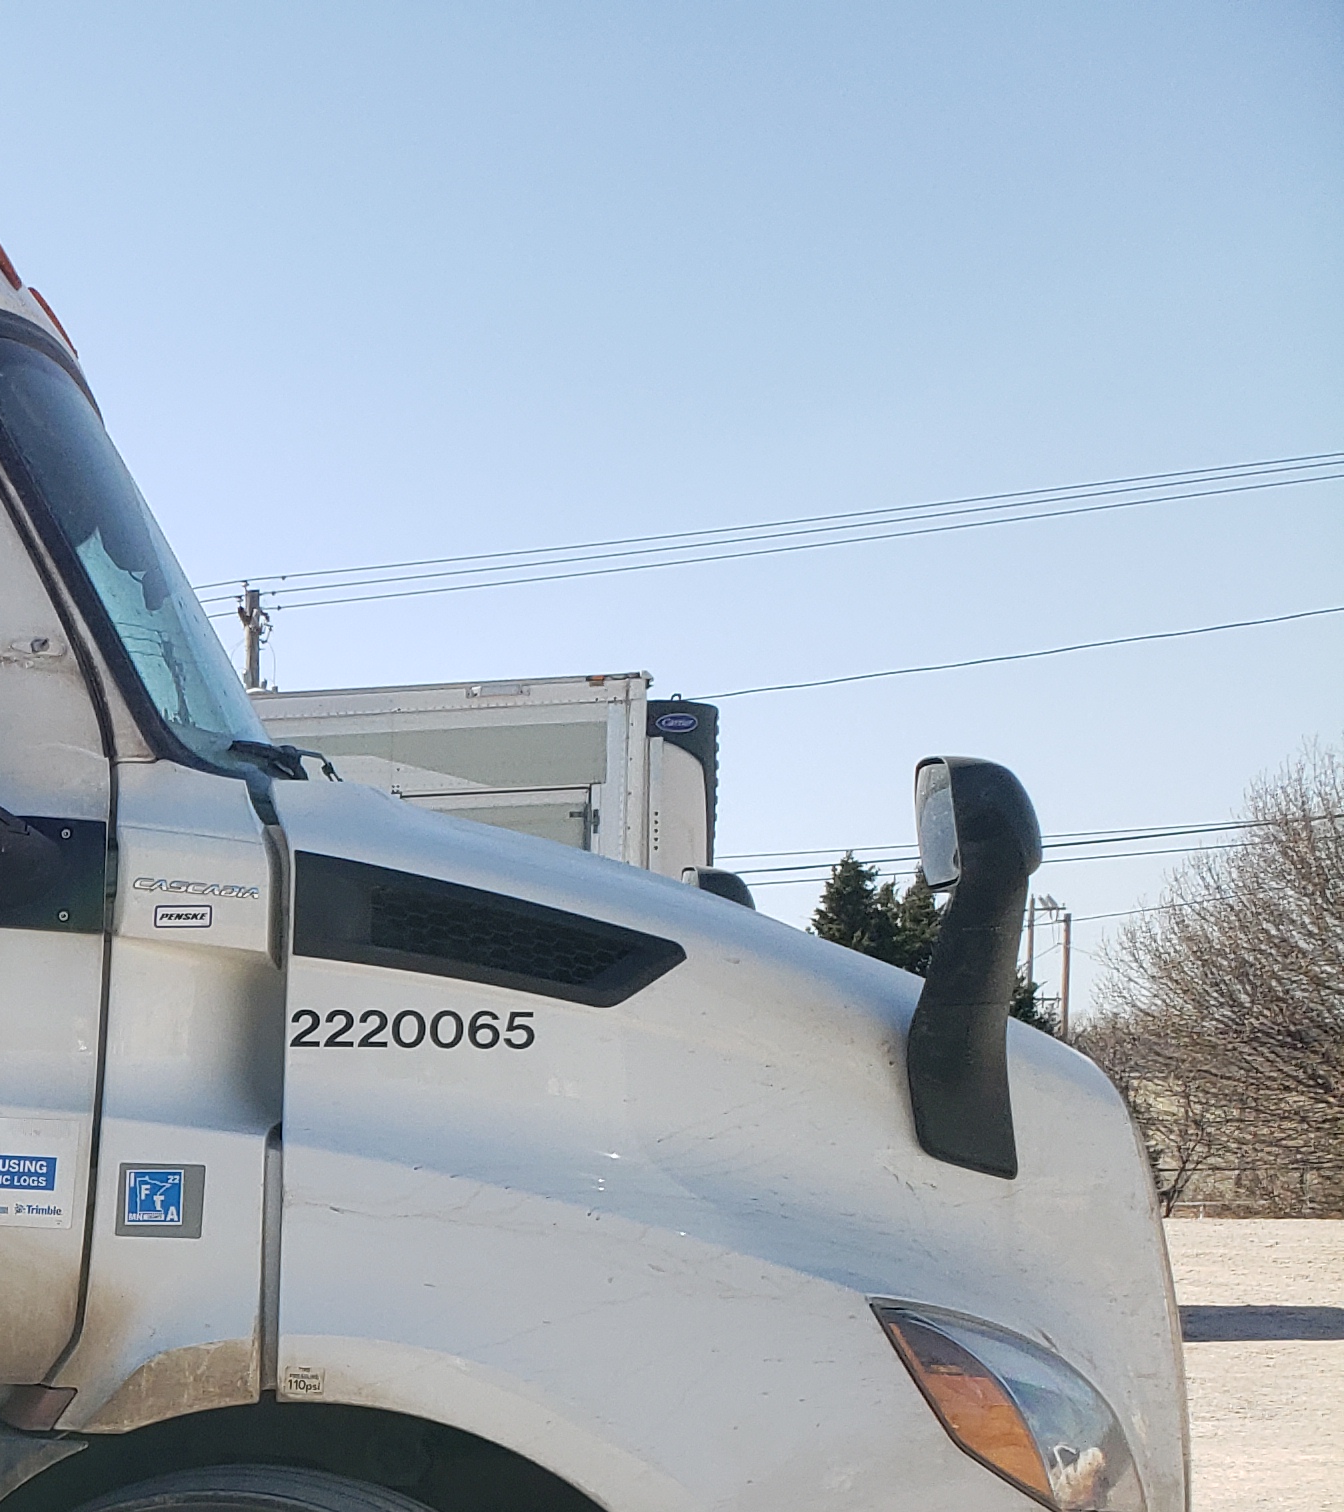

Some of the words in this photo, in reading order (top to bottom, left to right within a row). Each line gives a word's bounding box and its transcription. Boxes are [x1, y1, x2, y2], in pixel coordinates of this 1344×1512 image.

[133, 877, 260, 899] CASCADIA
[159, 912, 208, 922] PENSKE
[289, 1008, 536, 1050] 2220065
[13, 1175, 47, 1187] LOGS
[167, 1175, 180, 1184] 22
[26, 1204, 62, 1216] Trimble
